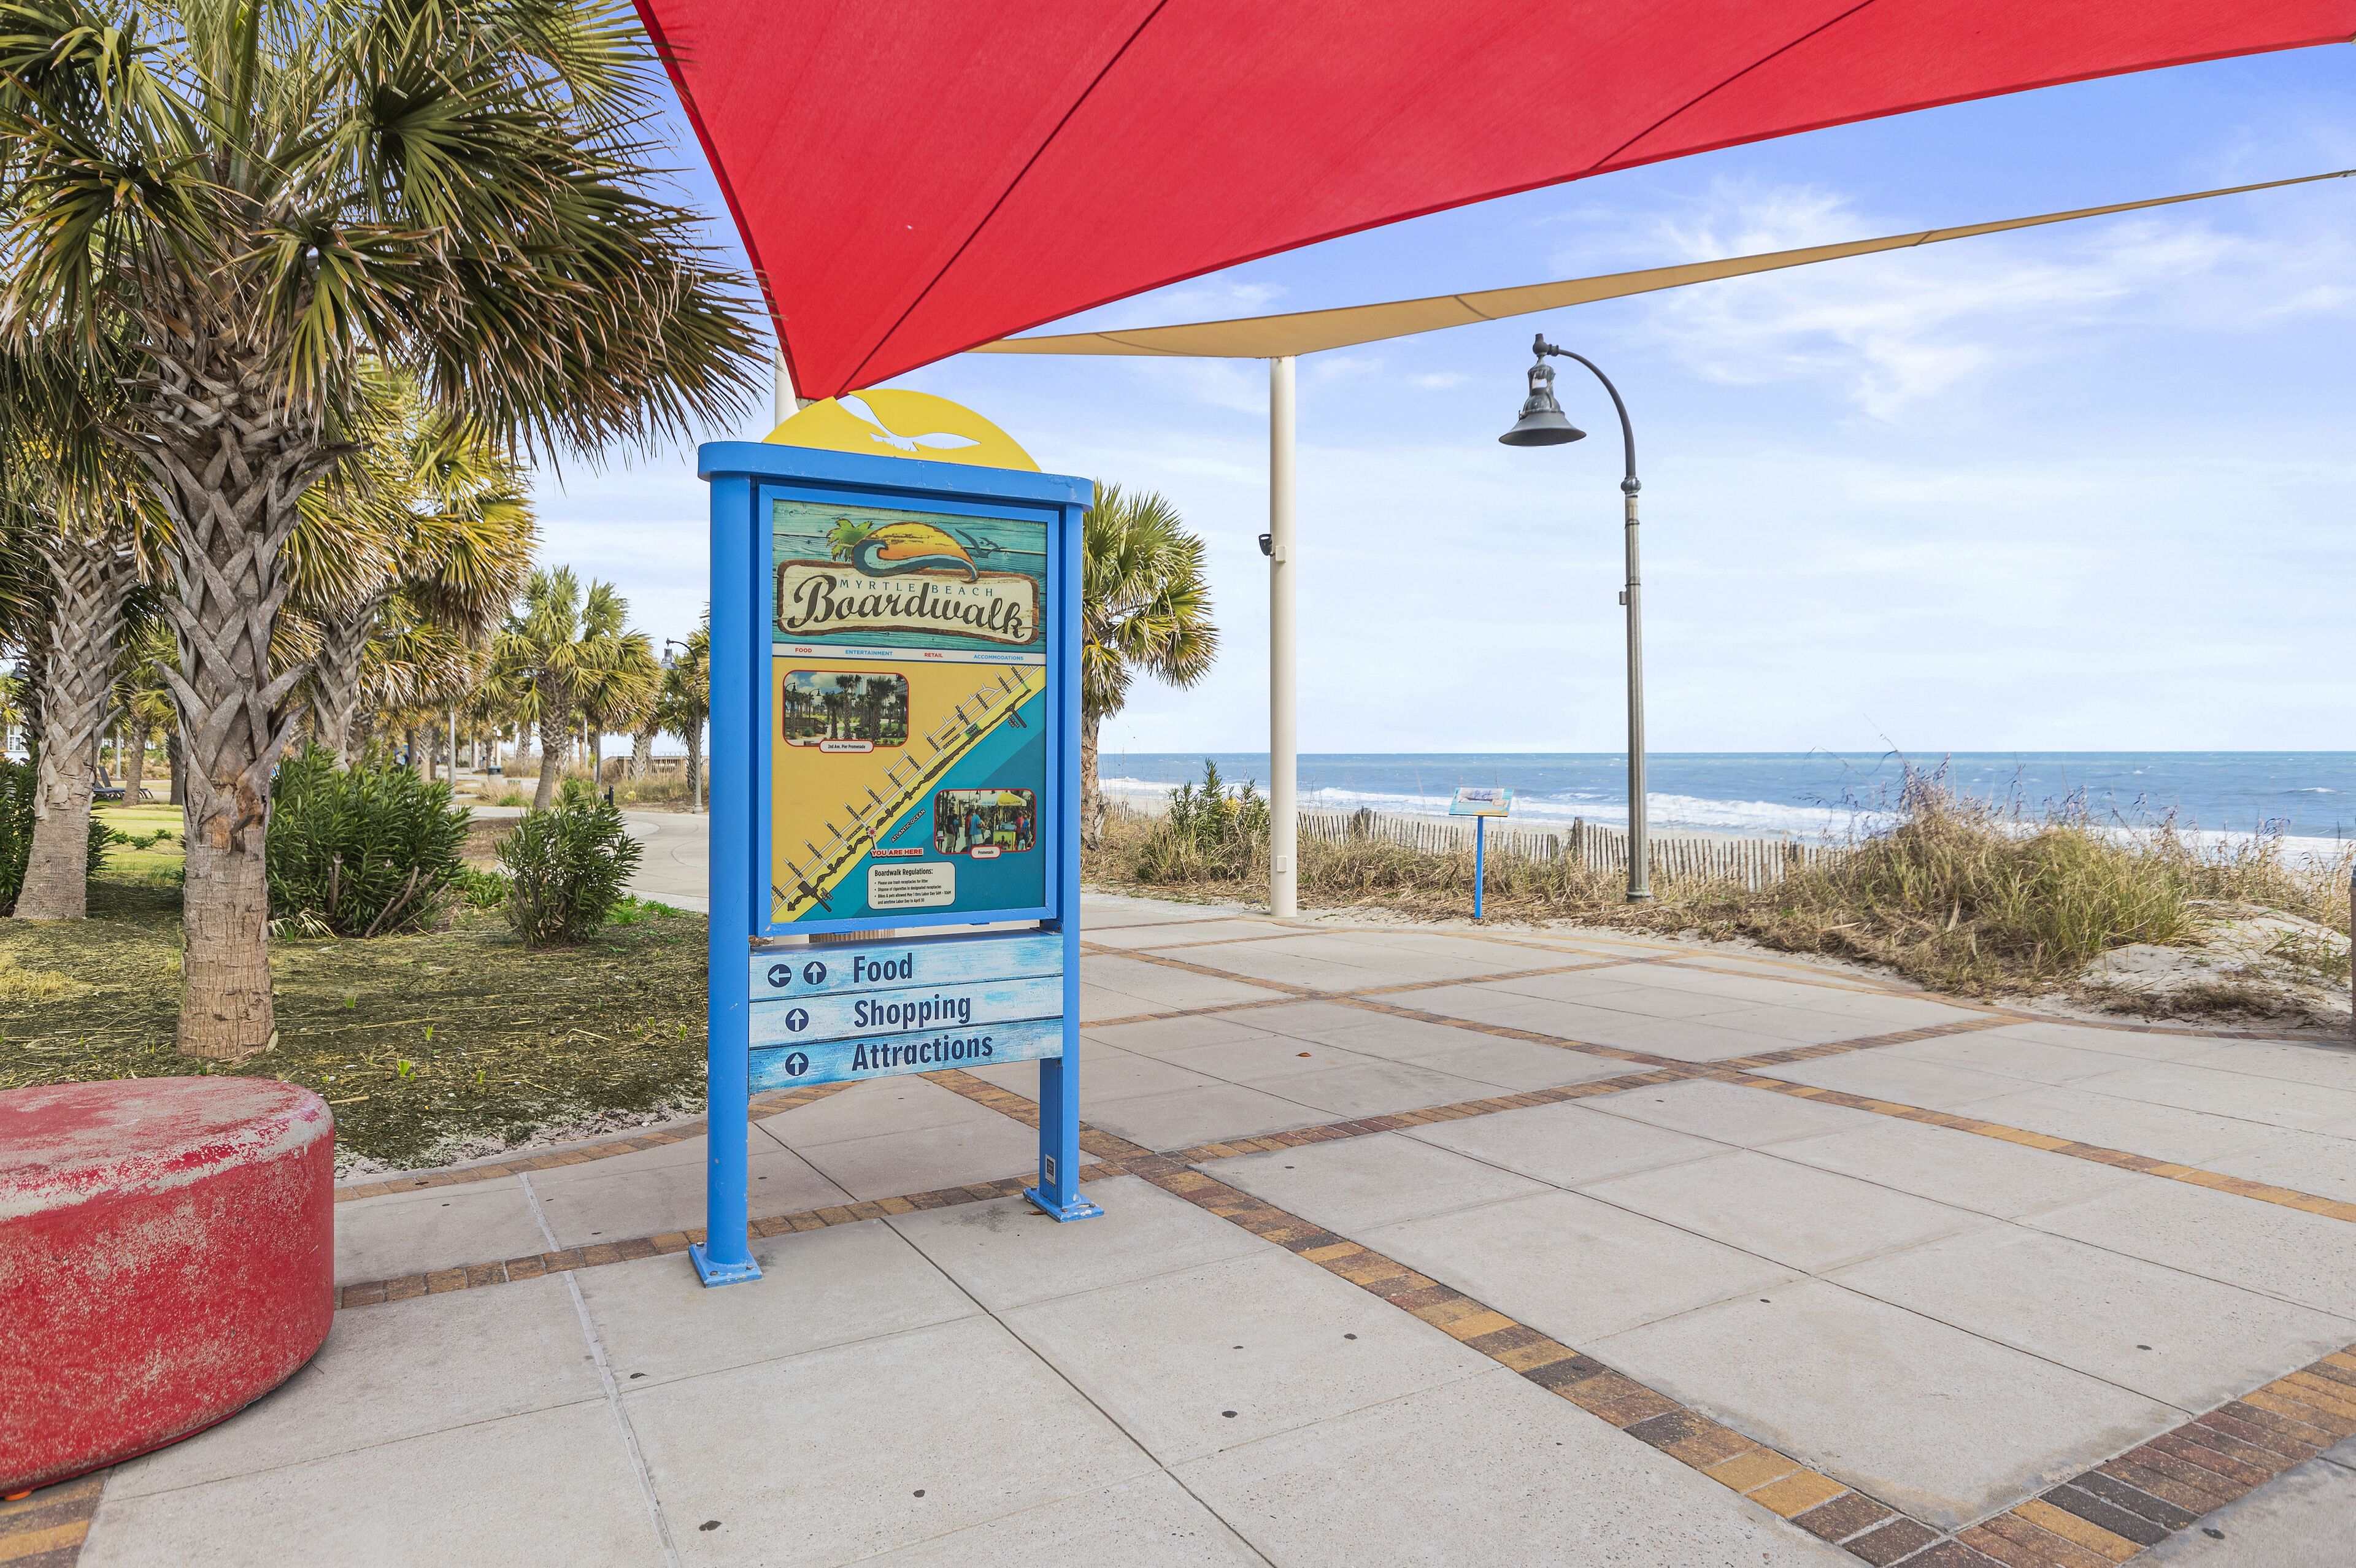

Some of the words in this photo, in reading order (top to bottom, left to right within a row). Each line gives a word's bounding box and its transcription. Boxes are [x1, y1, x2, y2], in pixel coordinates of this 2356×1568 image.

[840, 580, 915, 592] MYRTLE
[932, 585, 993, 597] BEACH
[787, 574, 1025, 639] Boardwalk
[891, 823, 911, 842] ATLANTIC
[911, 809, 925, 824] OCEAN
[853, 952, 912, 983] Food
[854, 993, 971, 1029] Shopping
[852, 1034, 993, 1071] Attractions
